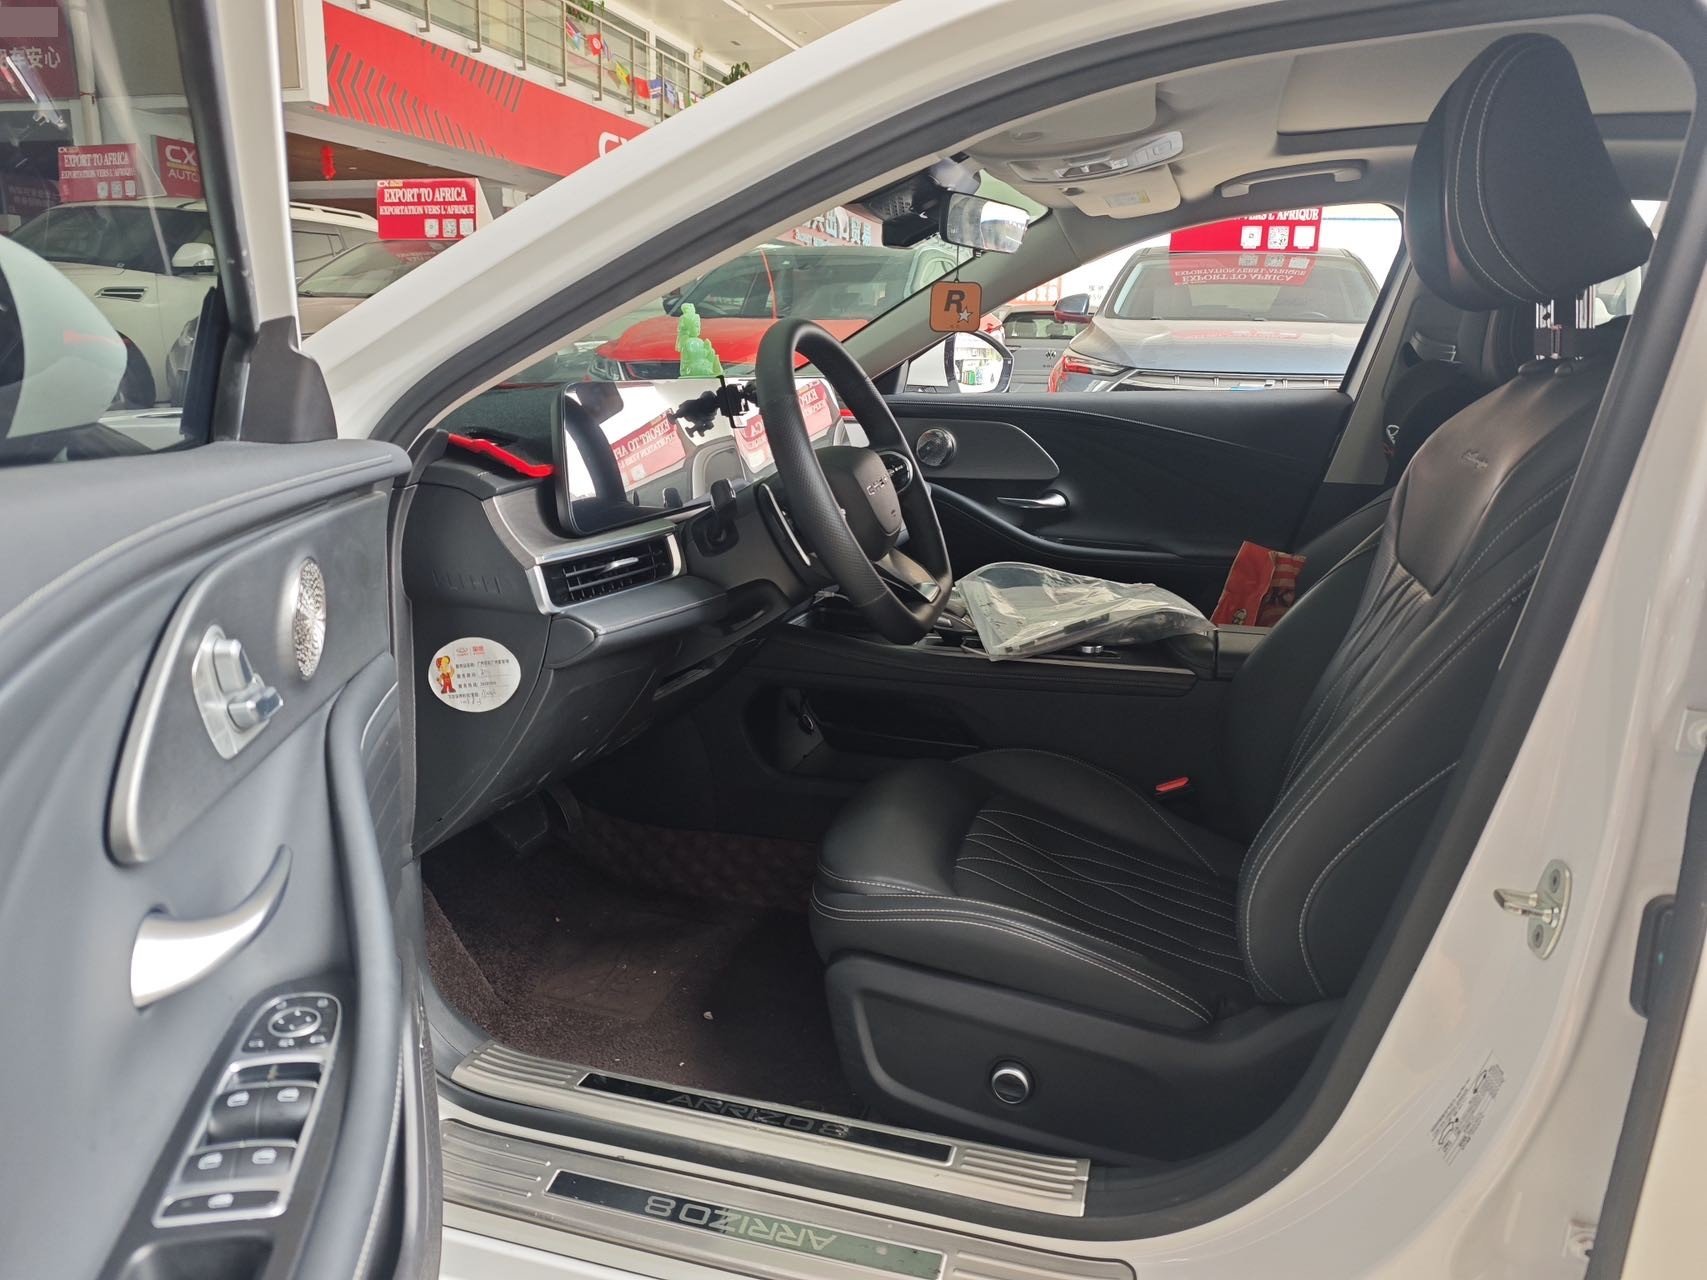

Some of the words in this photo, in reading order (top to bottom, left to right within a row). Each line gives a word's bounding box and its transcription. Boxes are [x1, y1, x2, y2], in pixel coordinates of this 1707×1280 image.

[165, 144, 198, 166] CX
[598, 131, 629, 159] C
[64, 153, 92, 167] EXPORT
[92, 153, 103, 166] TO
[103, 151, 129, 166] AFRICA
[383, 188, 418, 202] EXPORT
[418, 187, 433, 202] TO
[433, 187, 467, 202] AFRICA
[379, 205, 423, 215] EXPORTATION
[424, 205, 441, 214] VERS
[441, 204, 475, 215] L'AFRIQUE
[1267, 208, 1319, 221] LAFRIQUE
[944, 290, 966, 313] R
[666, 1094, 815, 1131] ARRIZO
[818, 1123, 849, 1137] 8
[644, 1195, 676, 1217] 8
[678, 1203, 837, 1250] ARRIZO
